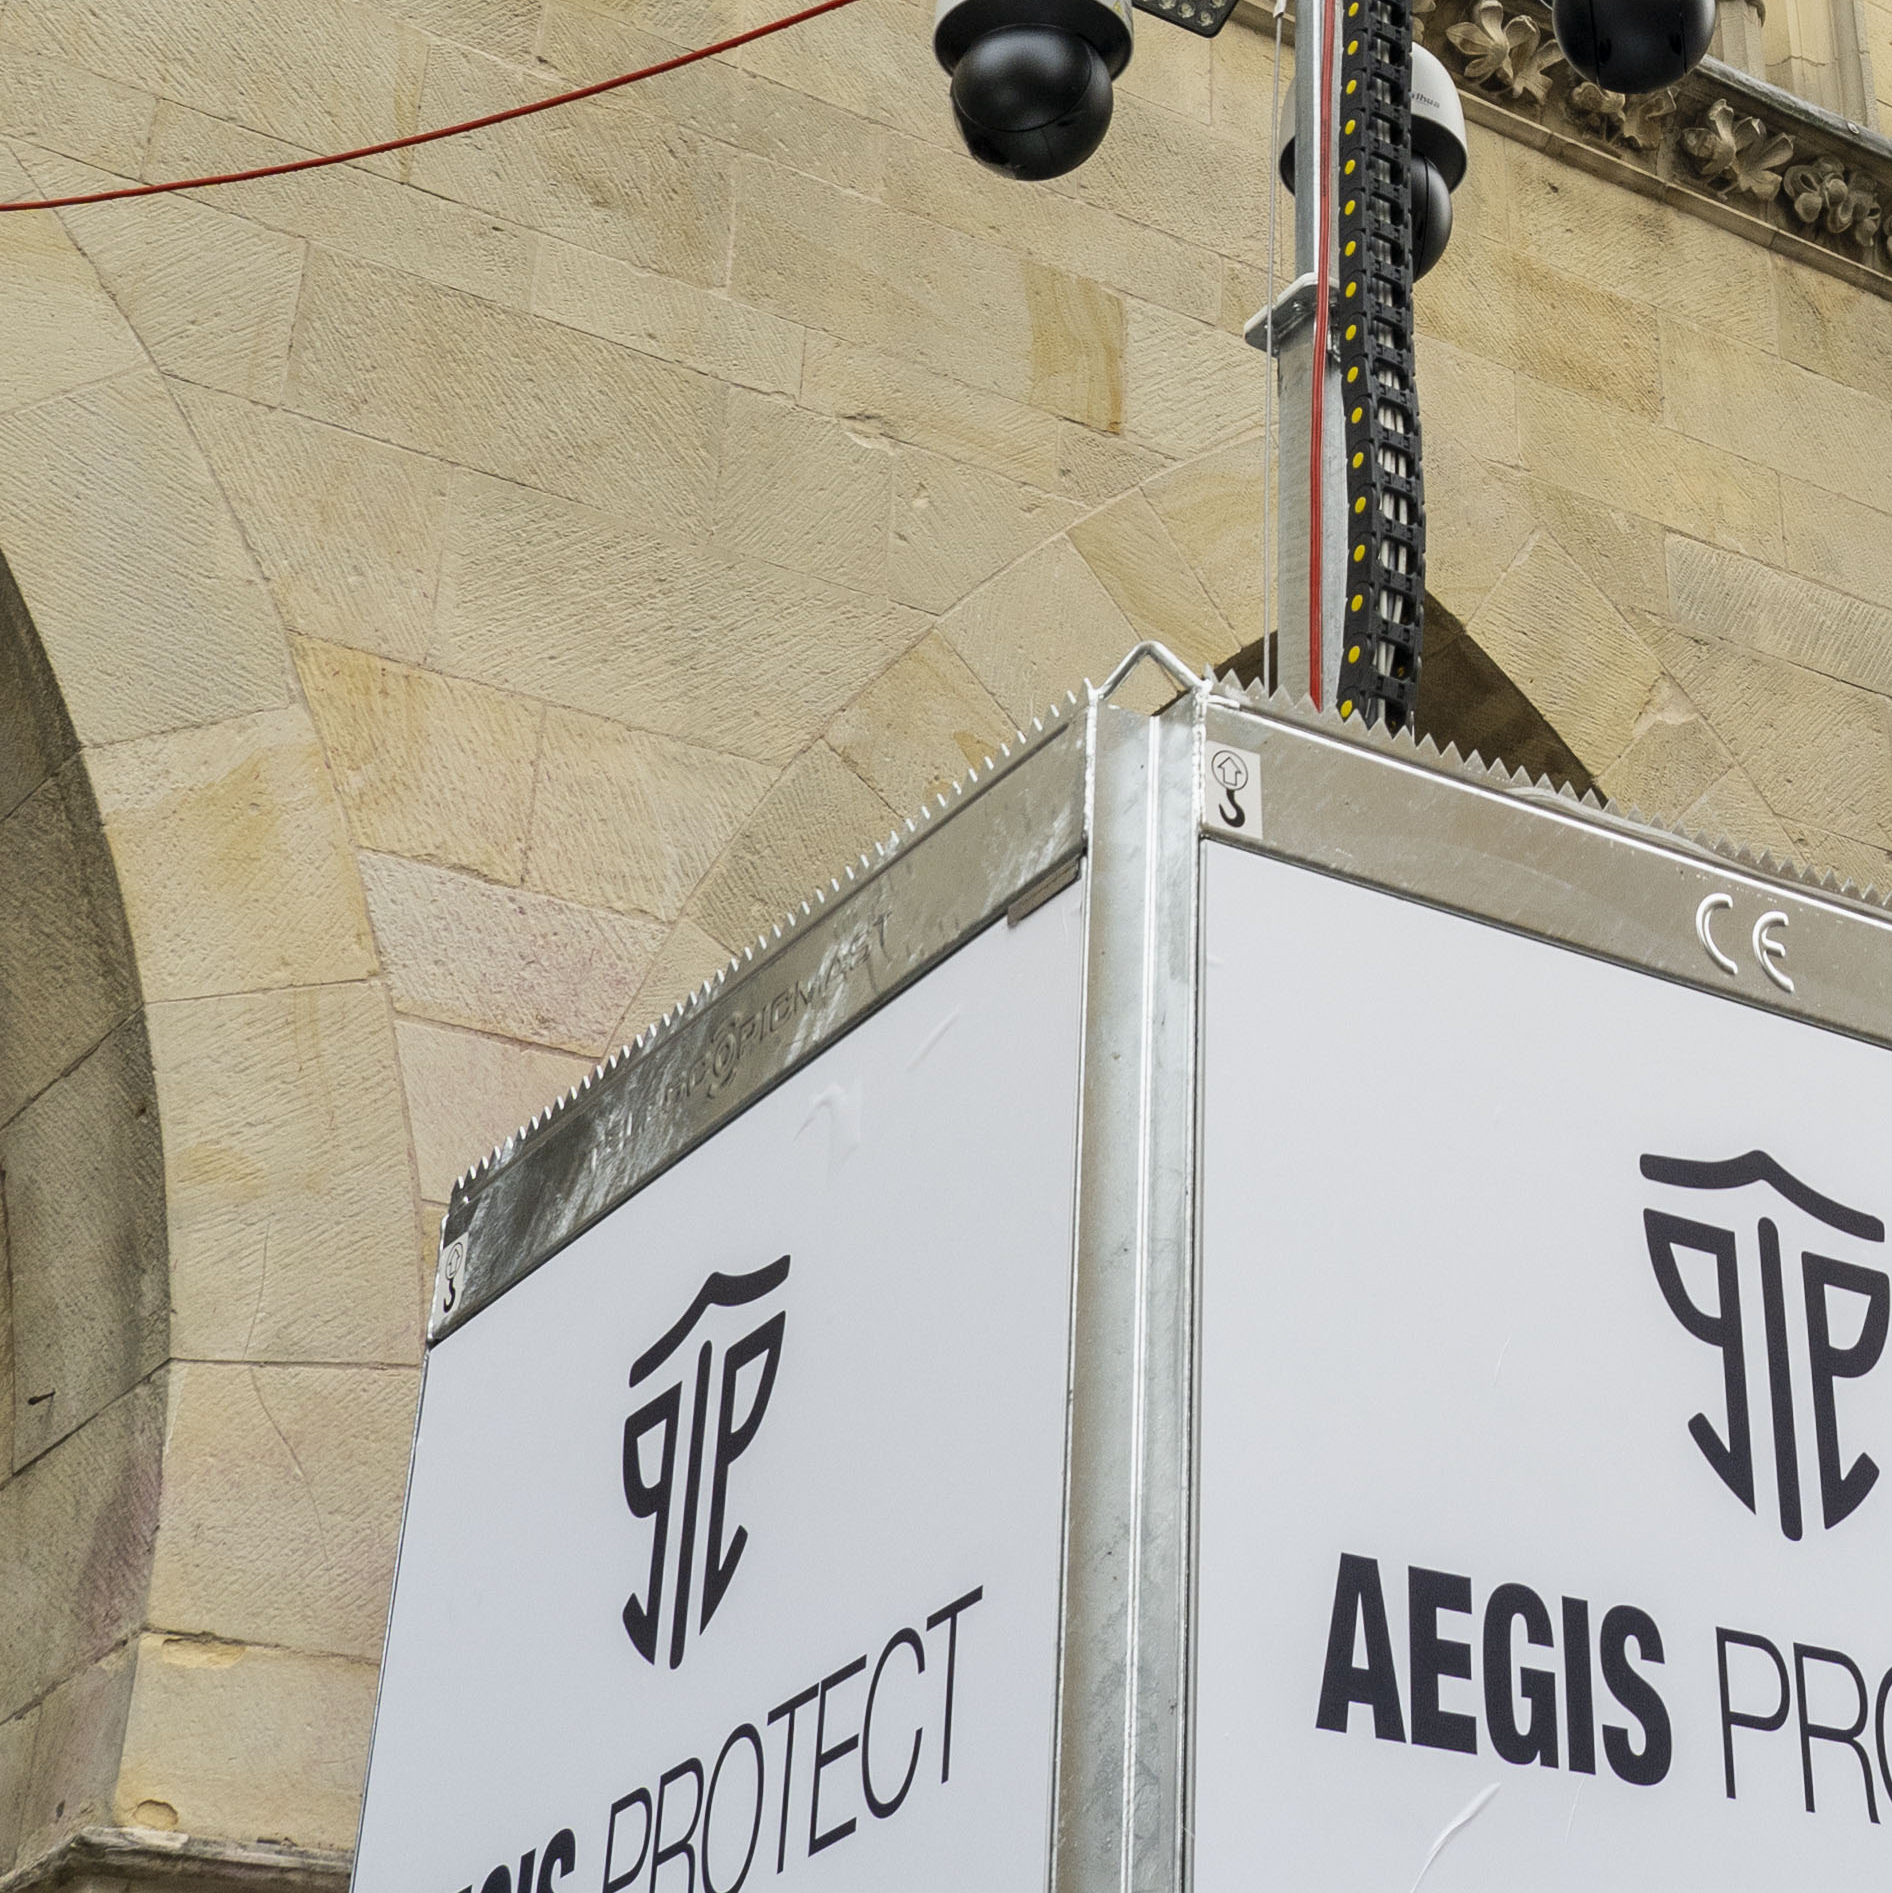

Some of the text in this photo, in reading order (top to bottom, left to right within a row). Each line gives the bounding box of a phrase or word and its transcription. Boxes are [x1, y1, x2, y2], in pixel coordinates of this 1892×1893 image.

[1696, 892, 1795, 993] CE
[603, 1585, 983, 1893] PROTECT
[1316, 1553, 1671, 1785] AEGIS
